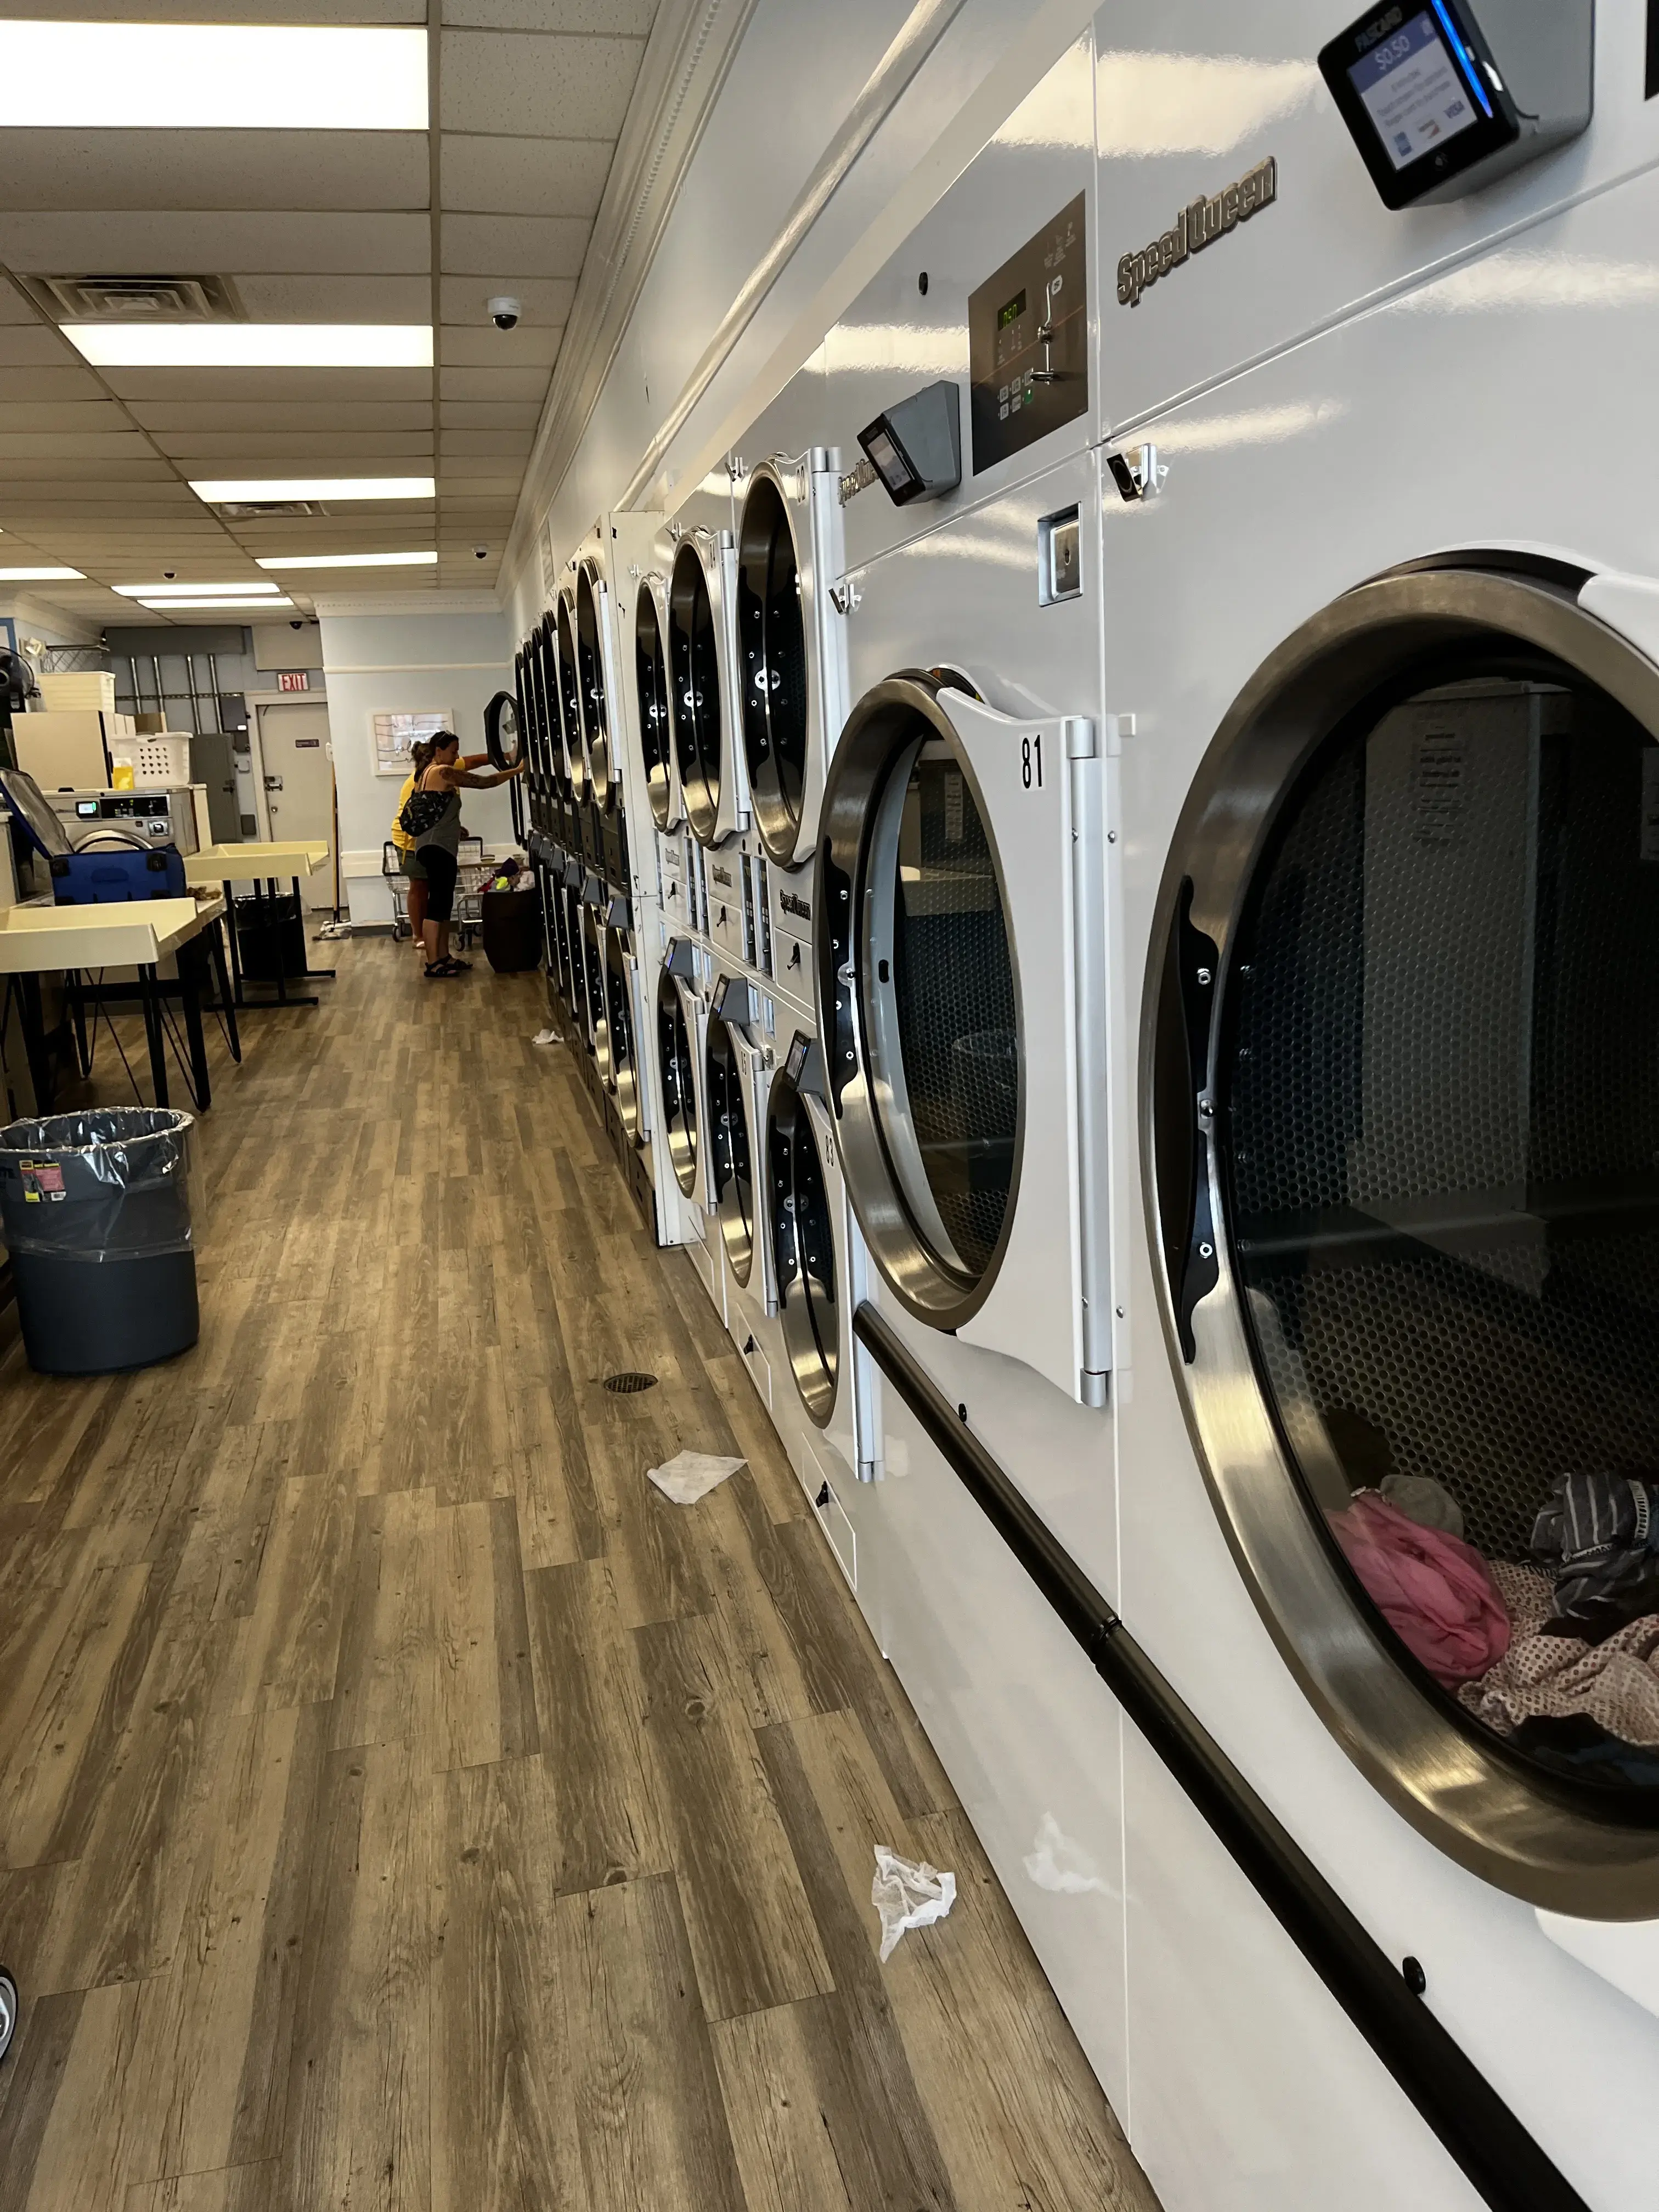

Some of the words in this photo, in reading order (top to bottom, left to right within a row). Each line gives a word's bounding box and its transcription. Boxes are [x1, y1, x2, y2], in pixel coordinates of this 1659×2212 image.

[1117, 205, 1189, 308] Speed
[1187, 156, 1277, 255] Queen
[281, 674, 306, 692] EXIT
[1022, 734, 1042, 789] 81
[826, 1135, 834, 1167] 83
